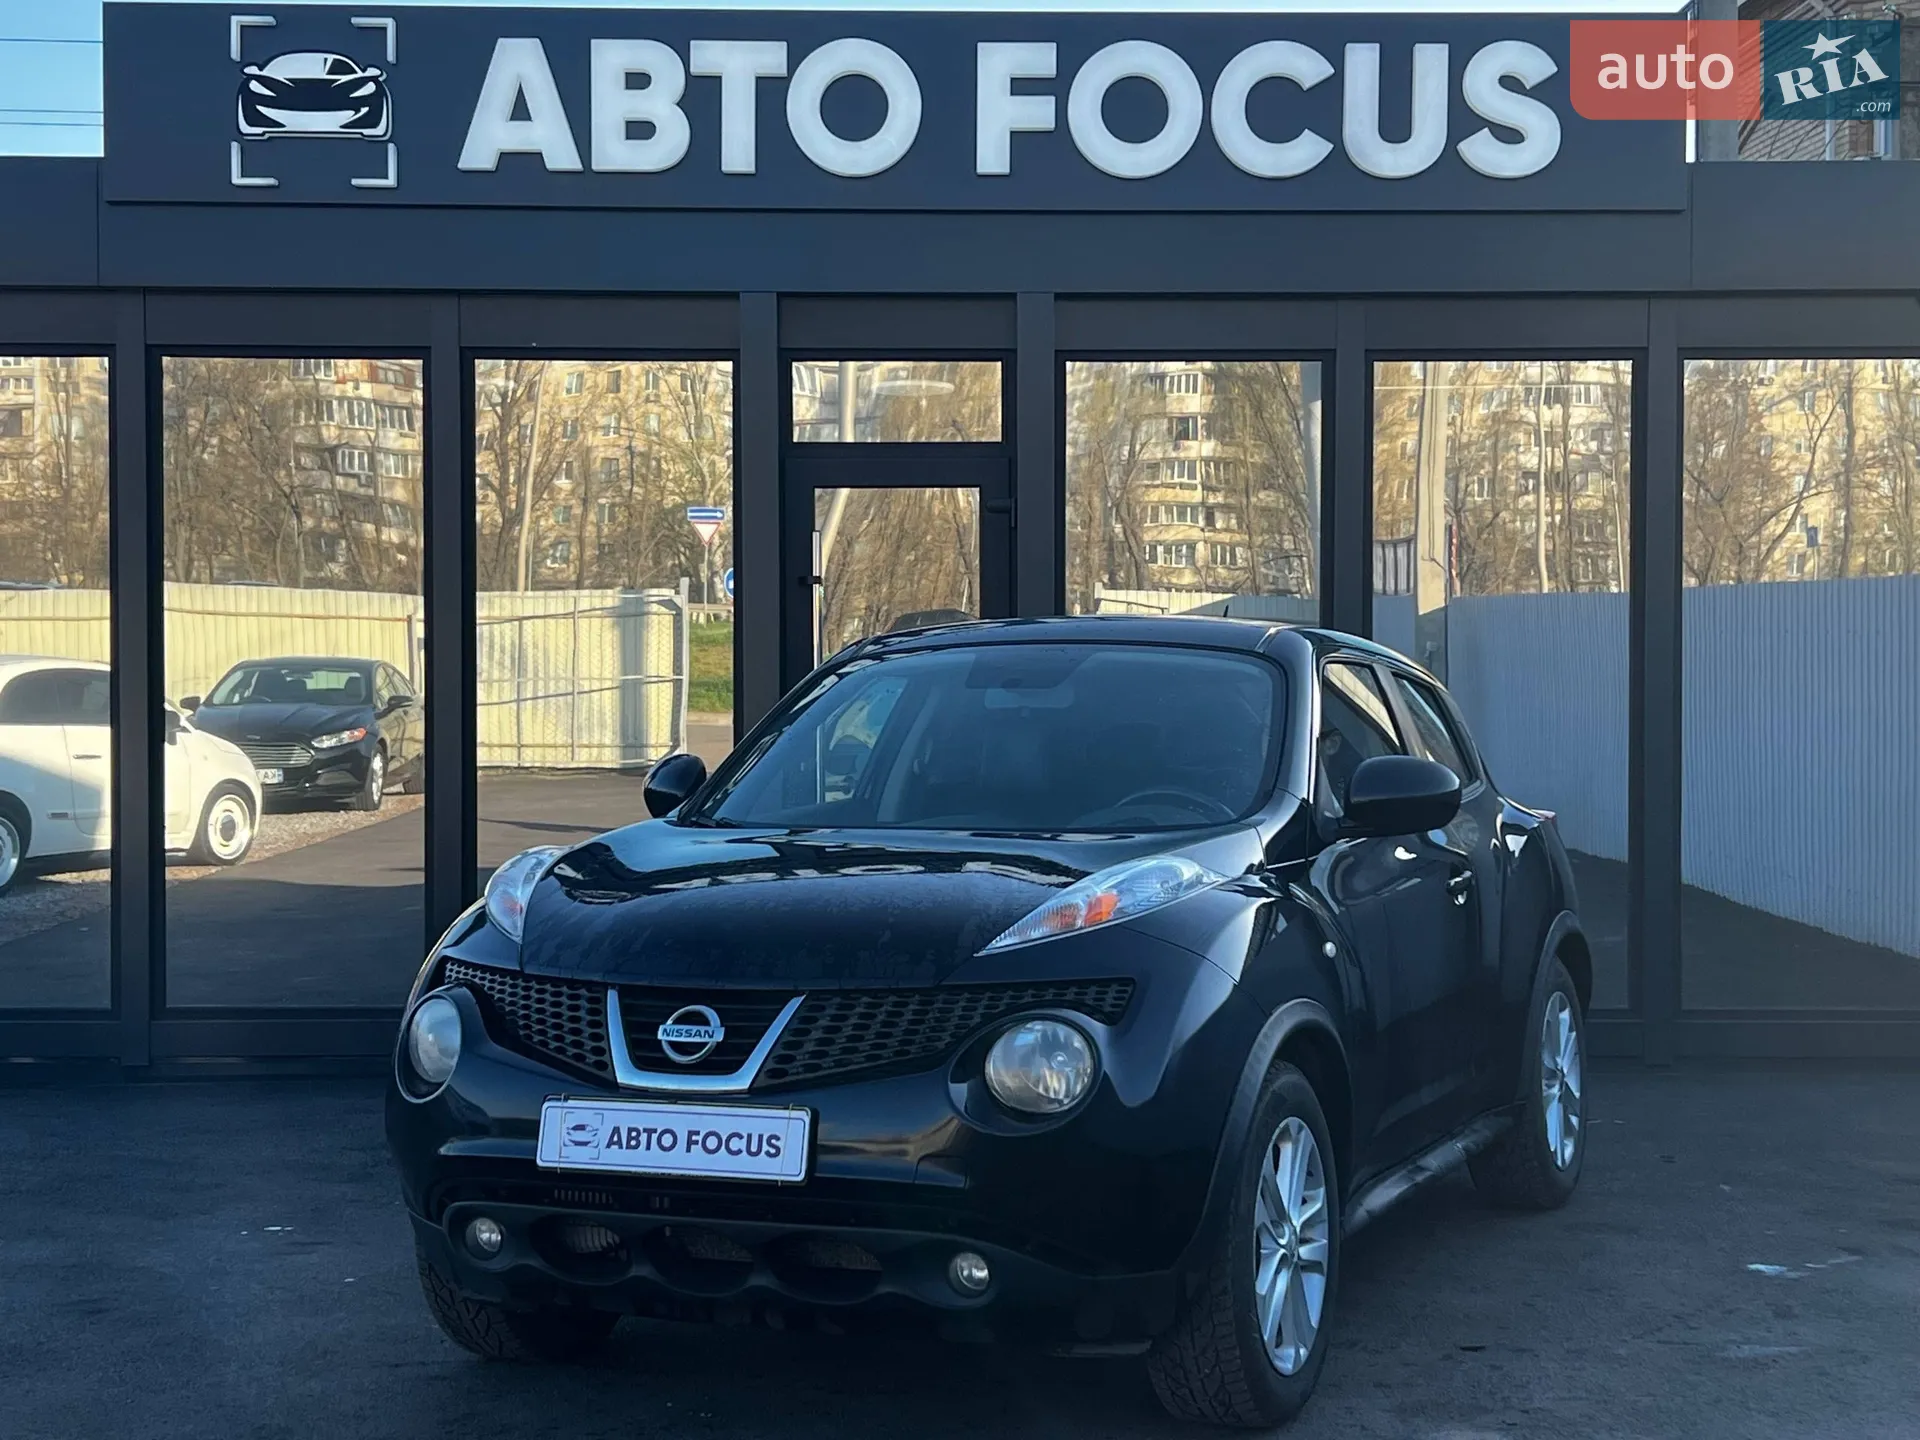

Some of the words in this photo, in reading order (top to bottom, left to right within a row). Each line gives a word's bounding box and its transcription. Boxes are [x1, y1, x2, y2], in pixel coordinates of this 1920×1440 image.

[456, 37, 923, 178] АВТО
[976, 39, 1562, 179] FOCUS
[661, 1028, 716, 1039] NISSAN
[605, 1126, 678, 1152] АВТО
[685, 1130, 782, 1159] FOCUS
